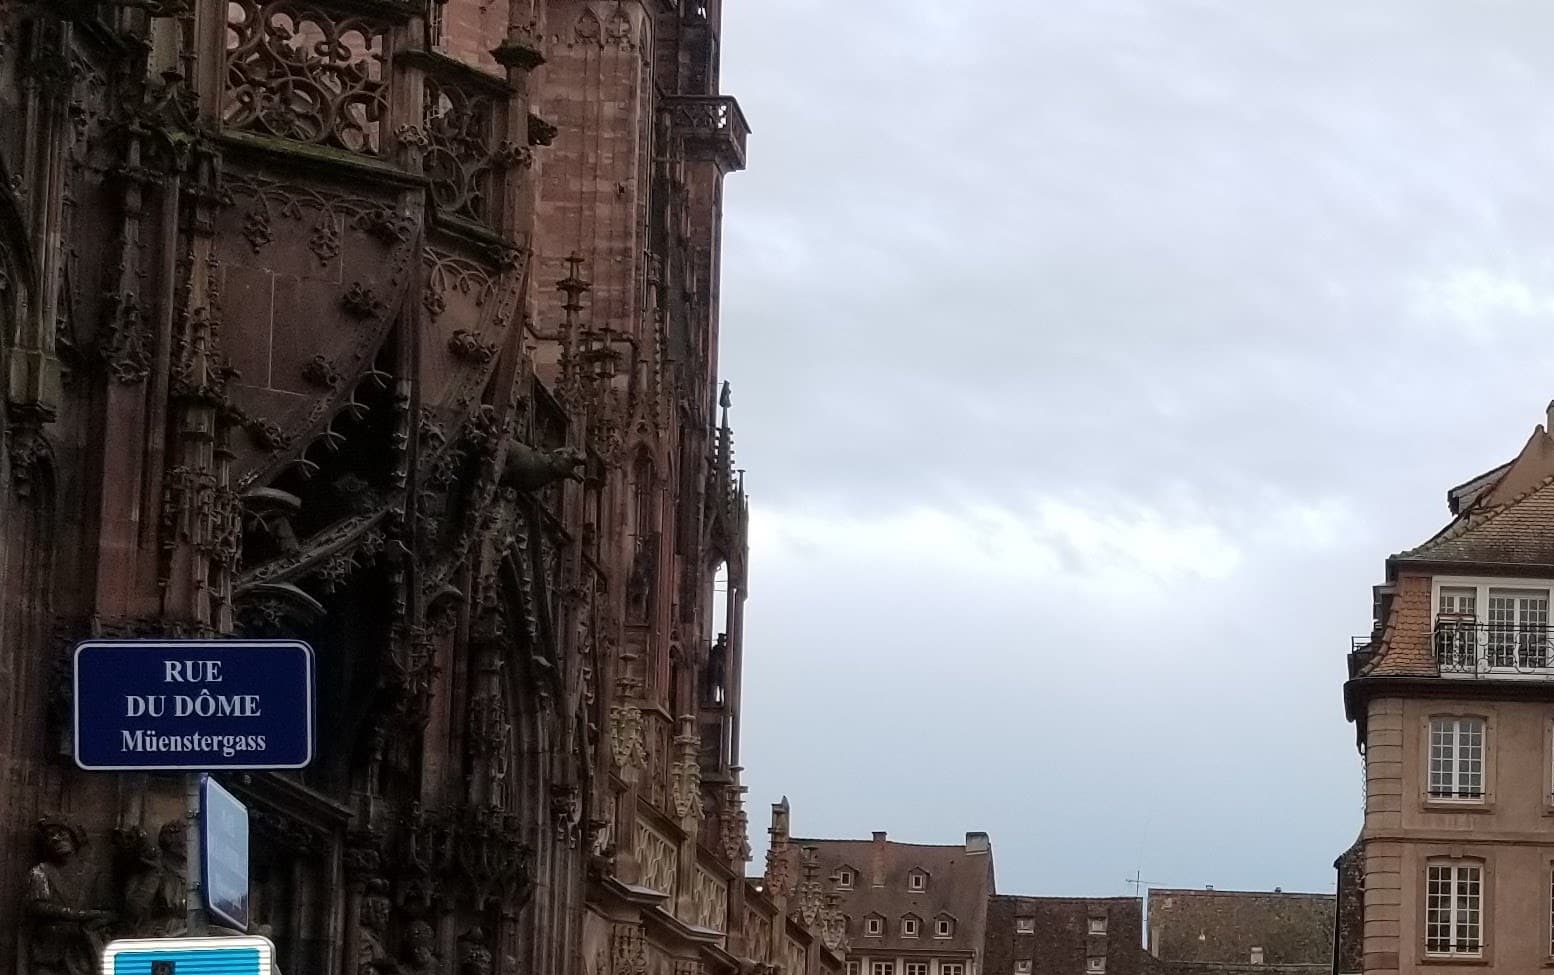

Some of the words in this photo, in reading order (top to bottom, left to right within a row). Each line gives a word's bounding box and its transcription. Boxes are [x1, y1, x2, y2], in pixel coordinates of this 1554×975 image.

[163, 660, 223, 682] RUE
[125, 695, 166, 717] DU
[173, 689, 261, 717] DÔME
[120, 729, 266, 757] Müenstergass
